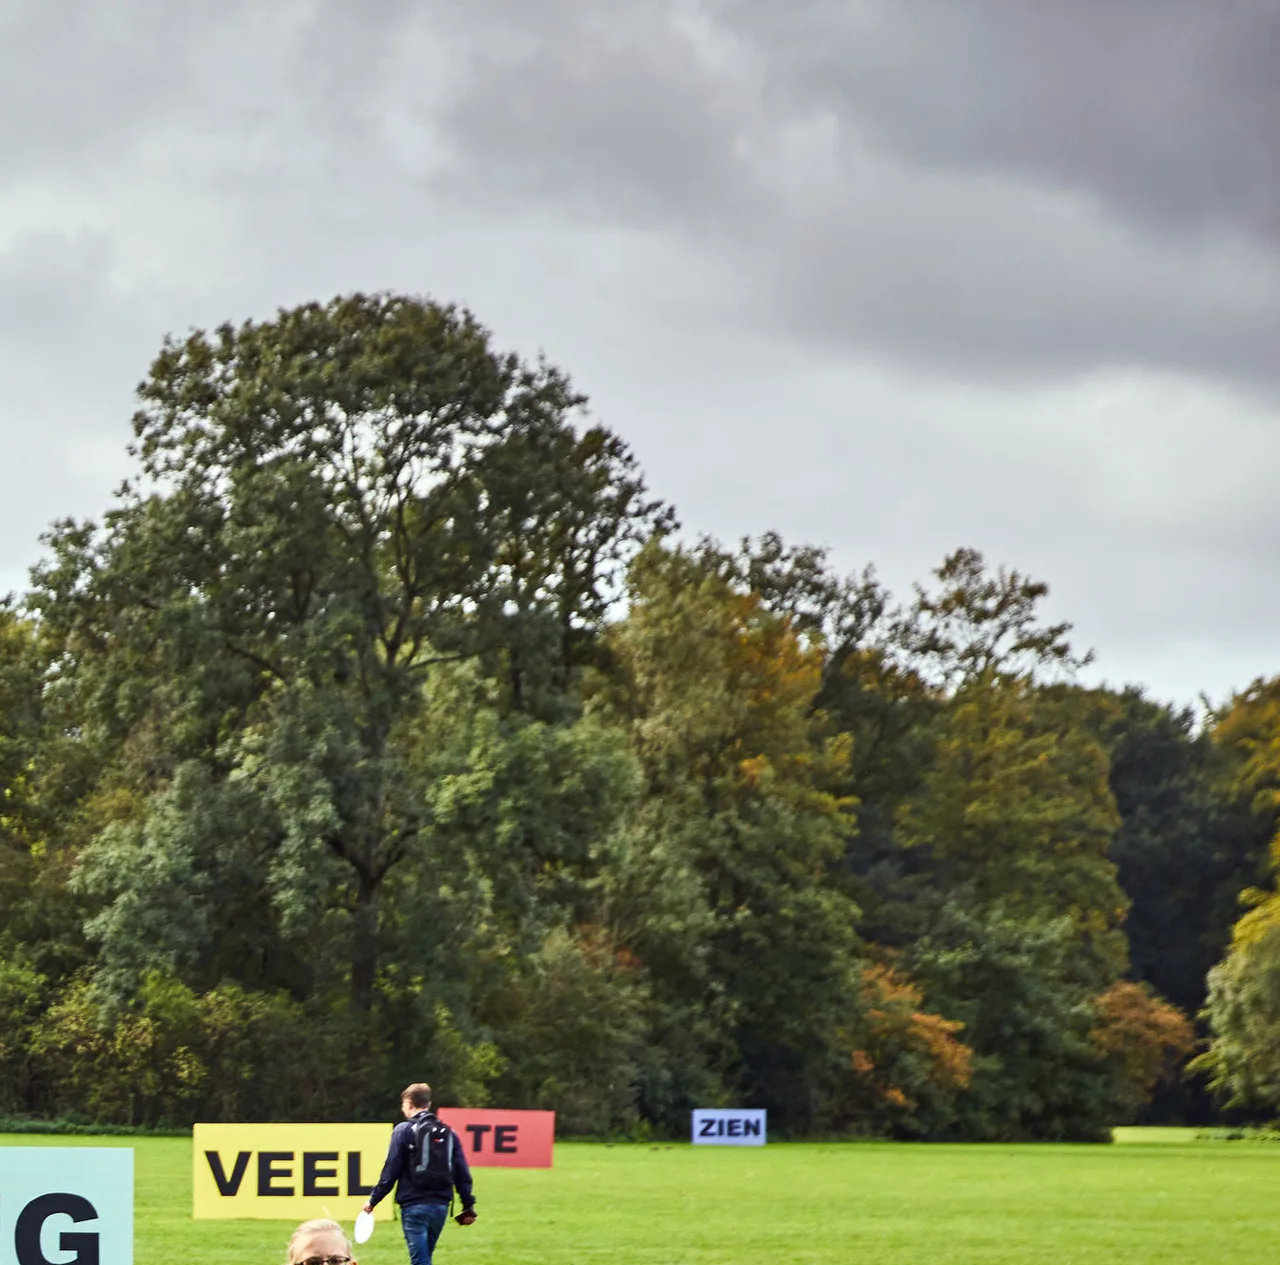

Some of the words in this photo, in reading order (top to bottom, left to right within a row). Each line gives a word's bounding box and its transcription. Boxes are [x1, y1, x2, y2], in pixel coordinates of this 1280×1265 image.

[465, 1124, 518, 1154] TE
[698, 1118, 761, 1138] ZIEN
[204, 1150, 376, 1198] VEEL
